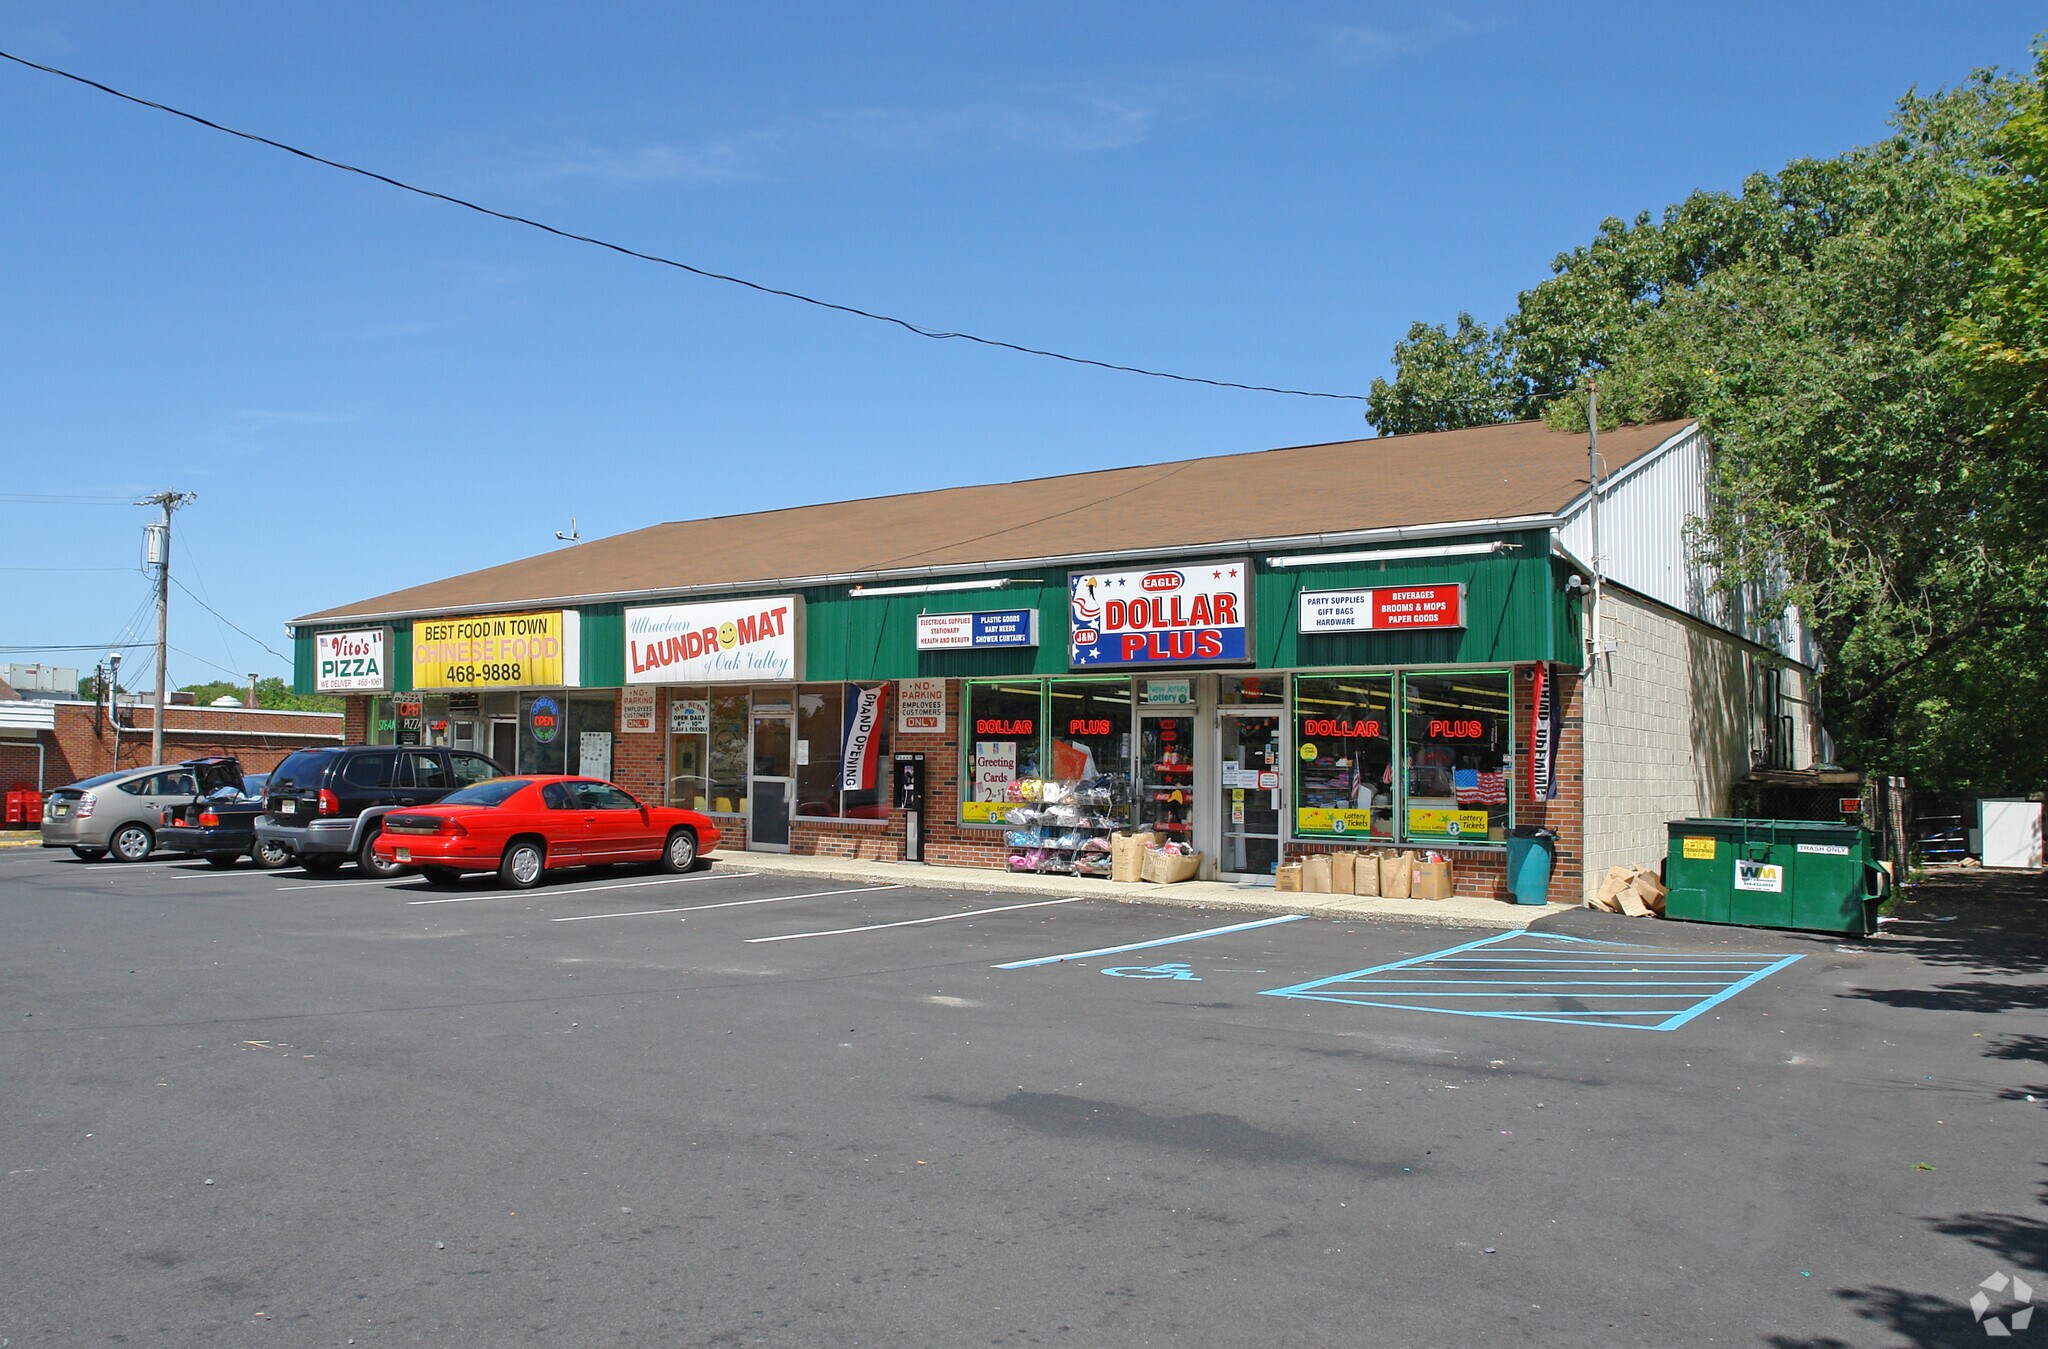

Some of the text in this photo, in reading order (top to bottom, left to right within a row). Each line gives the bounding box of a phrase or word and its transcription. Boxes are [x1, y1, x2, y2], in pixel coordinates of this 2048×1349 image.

[1144, 577, 1178, 587] EAGLE
[1331, 596, 1365, 604] SUPPLIES
[1393, 591, 1434, 600] BEVERAGES
[1106, 592, 1238, 630] DOLLAR
[1382, 604, 1414, 613] BROOMS
[1424, 602, 1446, 611] MOPS
[981, 616, 1001, 624] PLASTIC
[1316, 618, 1355, 626] HARDWARE
[1389, 614, 1439, 624] PAPER GOODS
[426, 619, 547, 641] BEST FOOD IN TOWN
[1077, 633, 1094, 642] J&M
[332, 635, 369, 657] Vito's
[416, 637, 559, 664] CHINESE FOOD
[1122, 630, 1222, 661] PLUS
[323, 658, 379, 678] PIZZA
[716, 650, 741, 671] Oak
[747, 650, 788, 677] Valley
[447, 663, 521, 682] 468-9888
[321, 680, 328, 688] WE
[915, 682, 929, 690] NO
[1167, 685, 1188, 693] Jersey
[902, 691, 942, 699] PARKING
[1149, 694, 1177, 702] Lottery
[860, 693, 877, 733] GRAND
[534, 716, 555, 726] OPEN
[977, 719, 1032, 734] DOLLAR
[1070, 719, 1110, 735] PLUS
[1305, 719, 1379, 737] DOLLAR
[1430, 720, 1482, 738] PLUS
[846, 735, 867, 786] OPENING
[978, 757, 1014, 769] Greeting
[984, 772, 1007, 782] Cards
[985, 788, 992, 802] 2
[1740, 866, 1776, 879] WM
